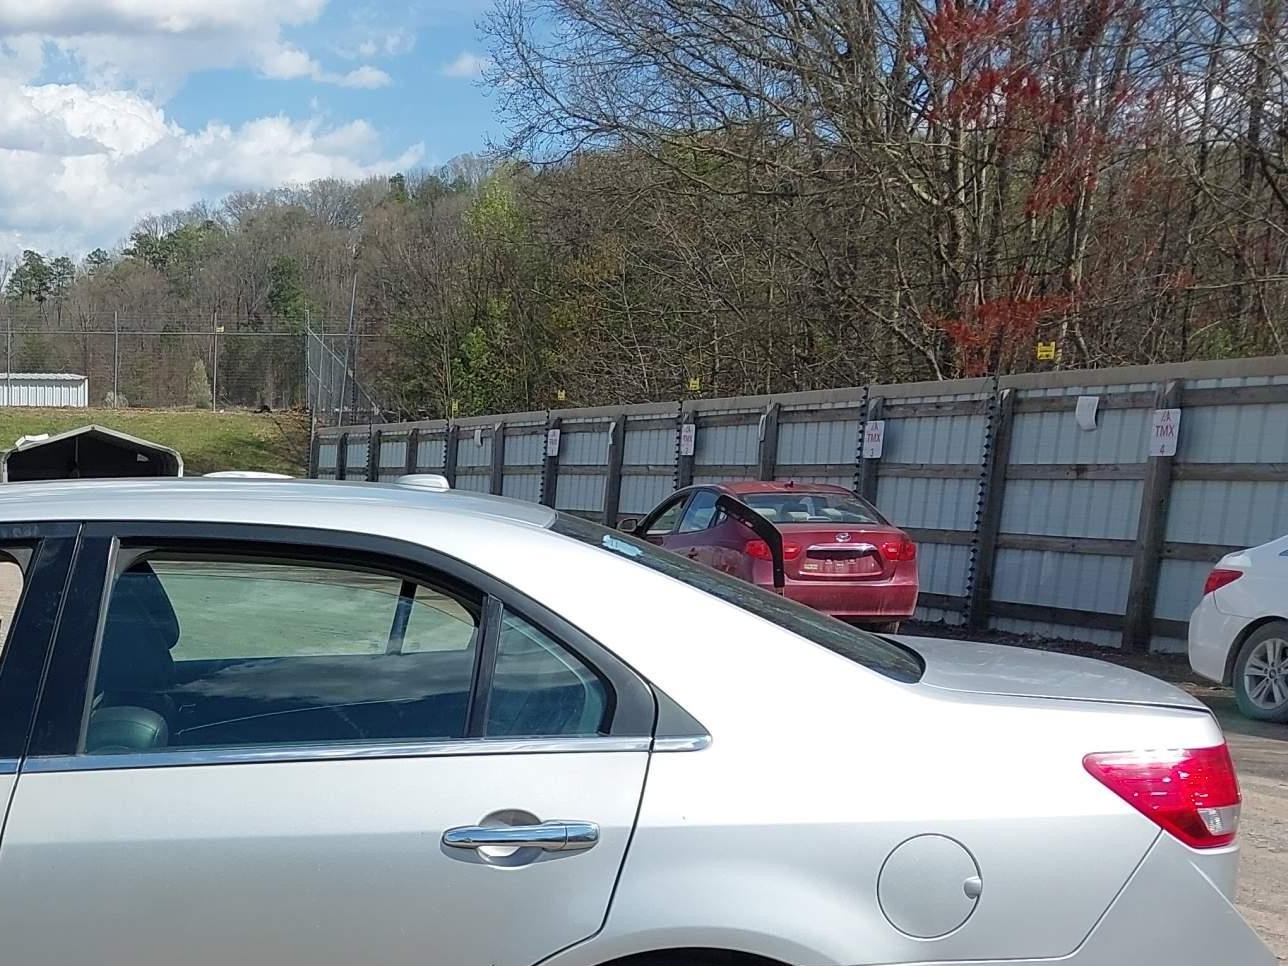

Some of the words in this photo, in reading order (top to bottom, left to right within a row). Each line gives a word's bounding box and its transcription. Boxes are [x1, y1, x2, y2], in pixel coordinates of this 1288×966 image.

[867, 432, 880, 443] TMX
[1155, 424, 1175, 438] TMX
[1159, 443, 1165, 456] 4
